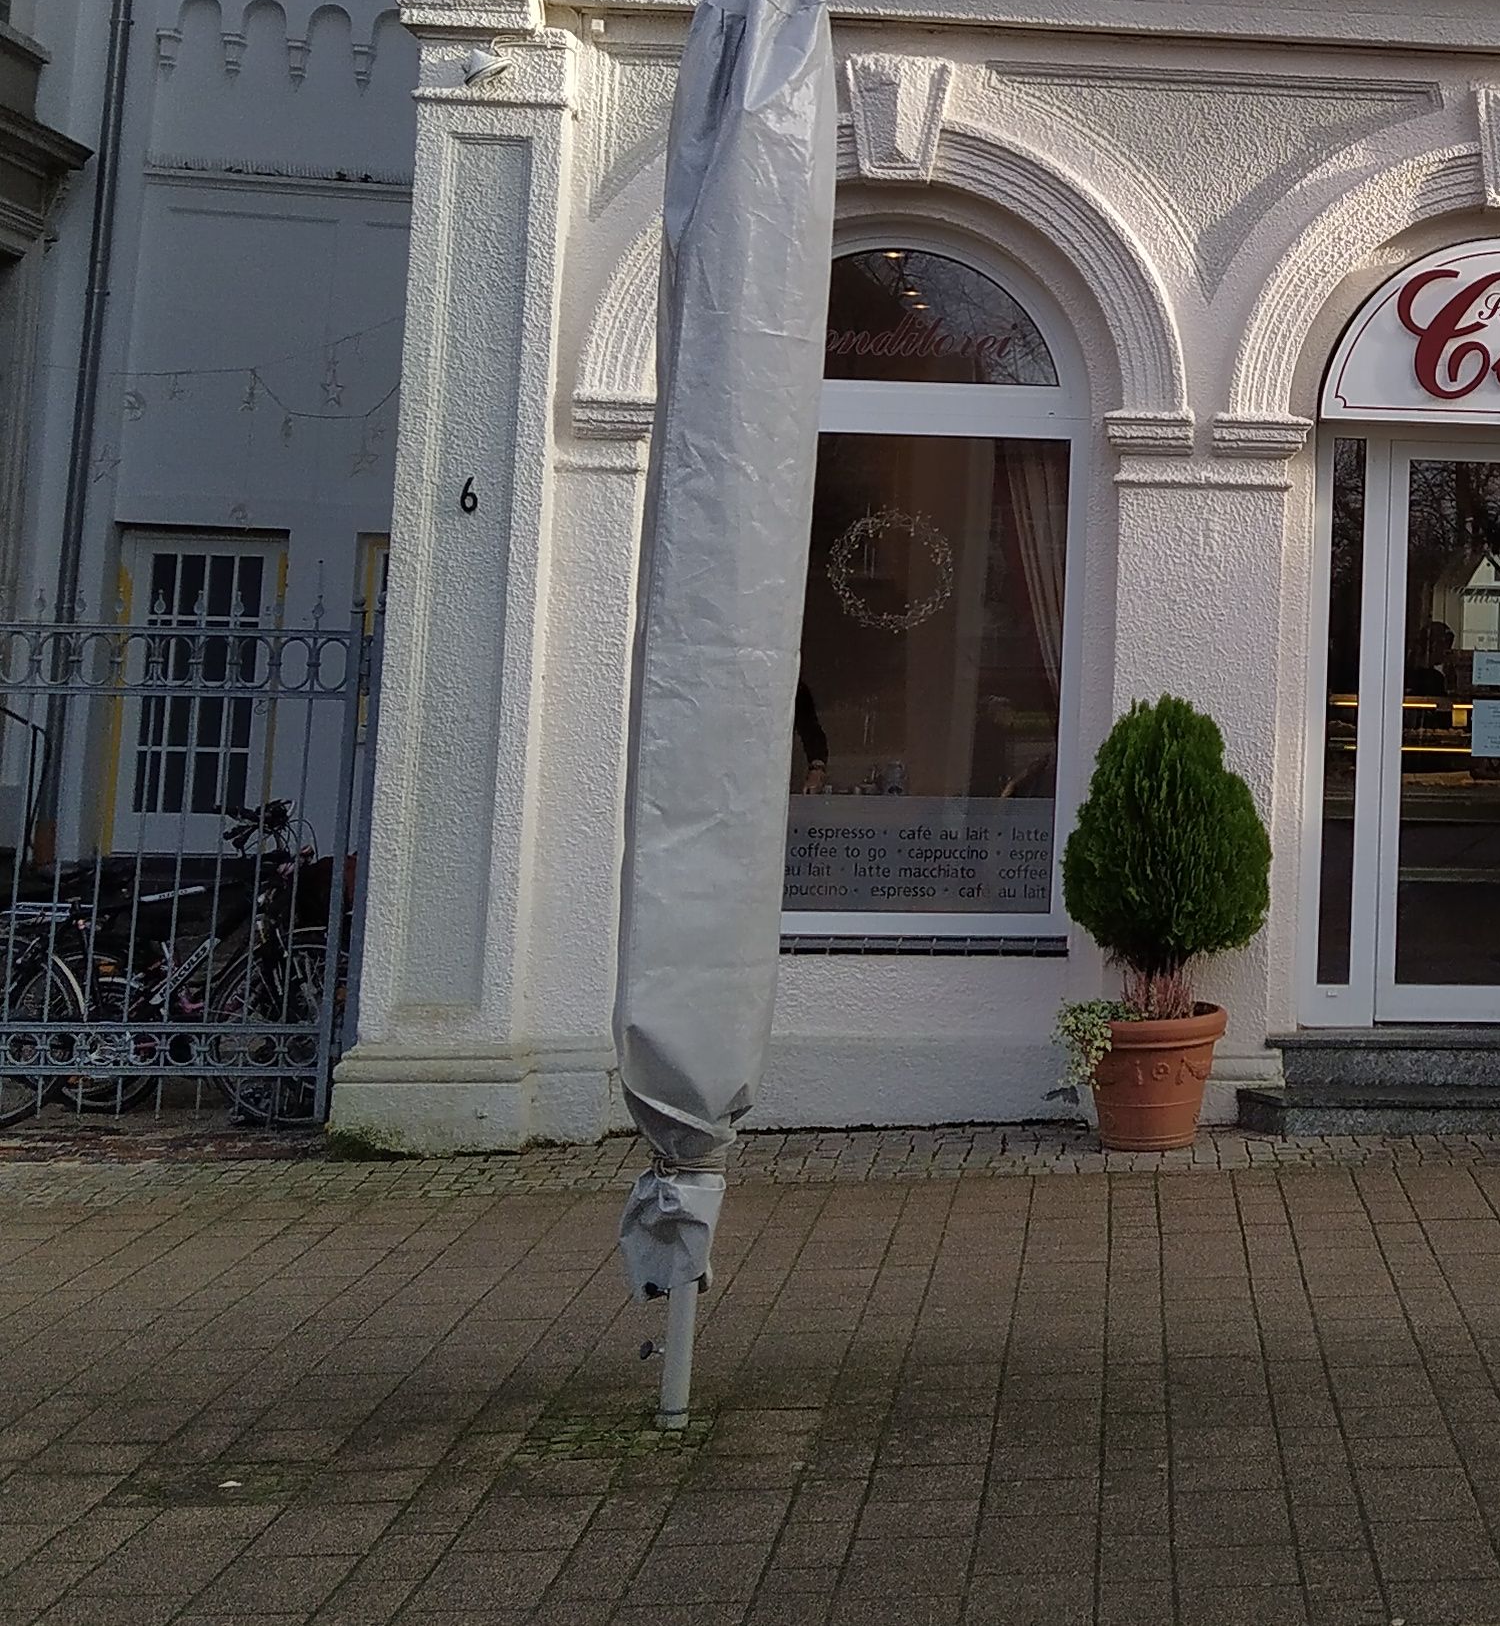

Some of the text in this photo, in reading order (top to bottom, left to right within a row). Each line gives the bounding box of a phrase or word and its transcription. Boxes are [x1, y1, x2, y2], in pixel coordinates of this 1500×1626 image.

[826, 313, 1013, 358] onditorei
[460, 475, 478, 515] 6
[807, 827, 876, 841] espresso
[939, 829, 958, 840] au
[966, 826, 990, 840] lait
[1012, 827, 1049, 841] latte
[790, 843, 838, 858] coffee
[845, 845, 860, 858] to
[868, 847, 887, 862] go
[908, 844, 988, 862] cappuccino
[808, 863, 832, 877] lait
[854, 863, 891, 878] latte
[898, 863, 976, 878] macchiato
[999, 864, 1048, 879] coffee
[870, 885, 937, 900] espresso
[998, 886, 1016, 899] au
[1023, 883, 1046, 899] lait
